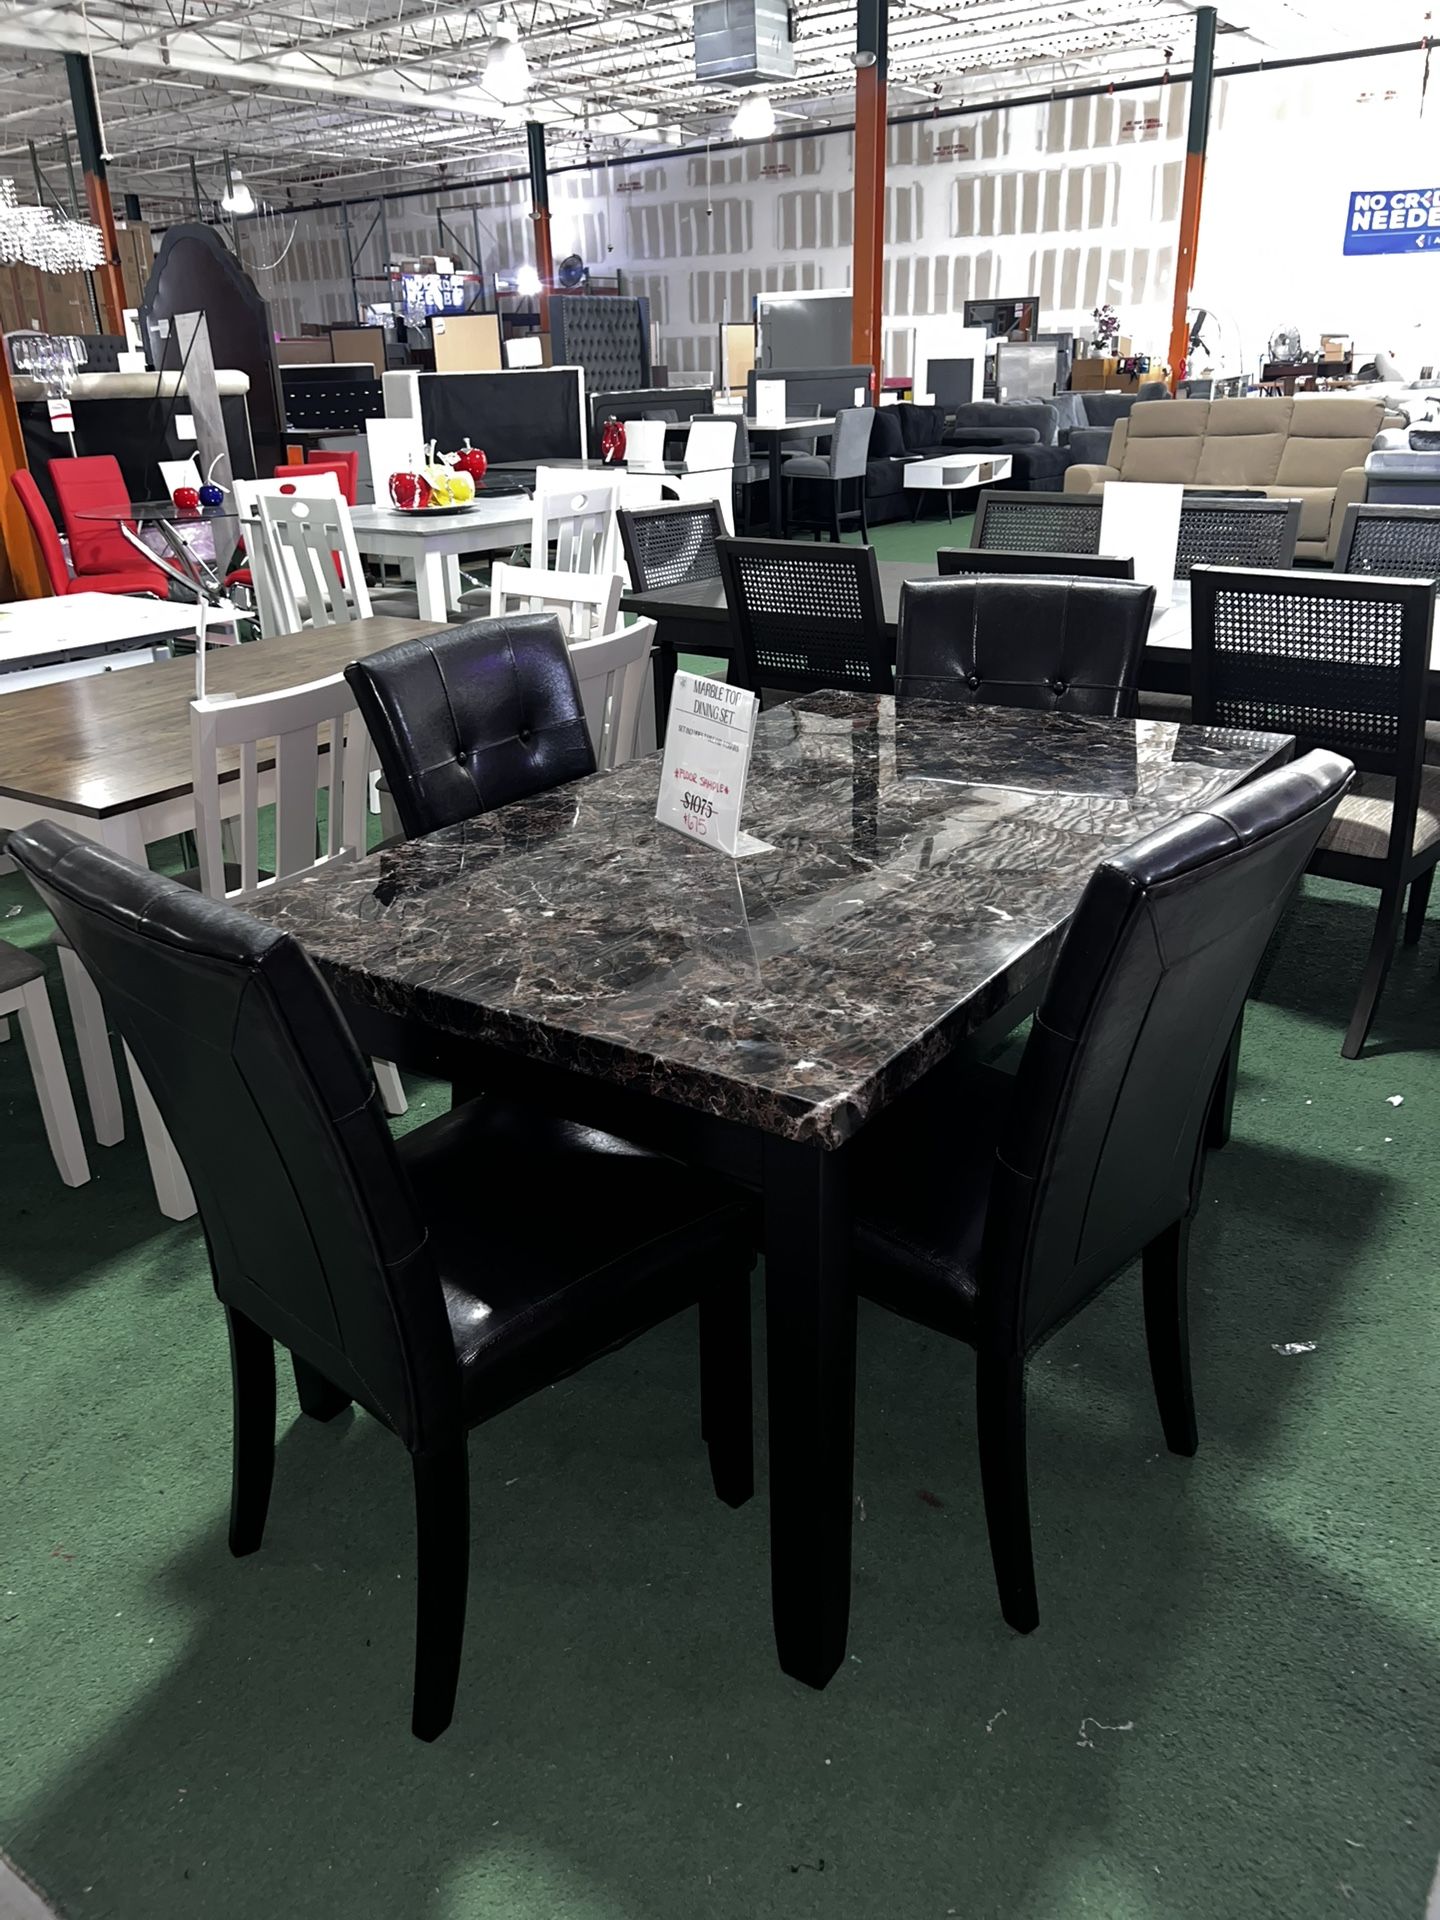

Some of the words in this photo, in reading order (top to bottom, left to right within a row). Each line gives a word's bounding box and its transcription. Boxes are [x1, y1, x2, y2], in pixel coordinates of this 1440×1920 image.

[1354, 194, 1387, 211] NO
[693, 679, 725, 701] MARBLE
[693, 699, 720, 720] DINING
[719, 708, 736, 725] SET
